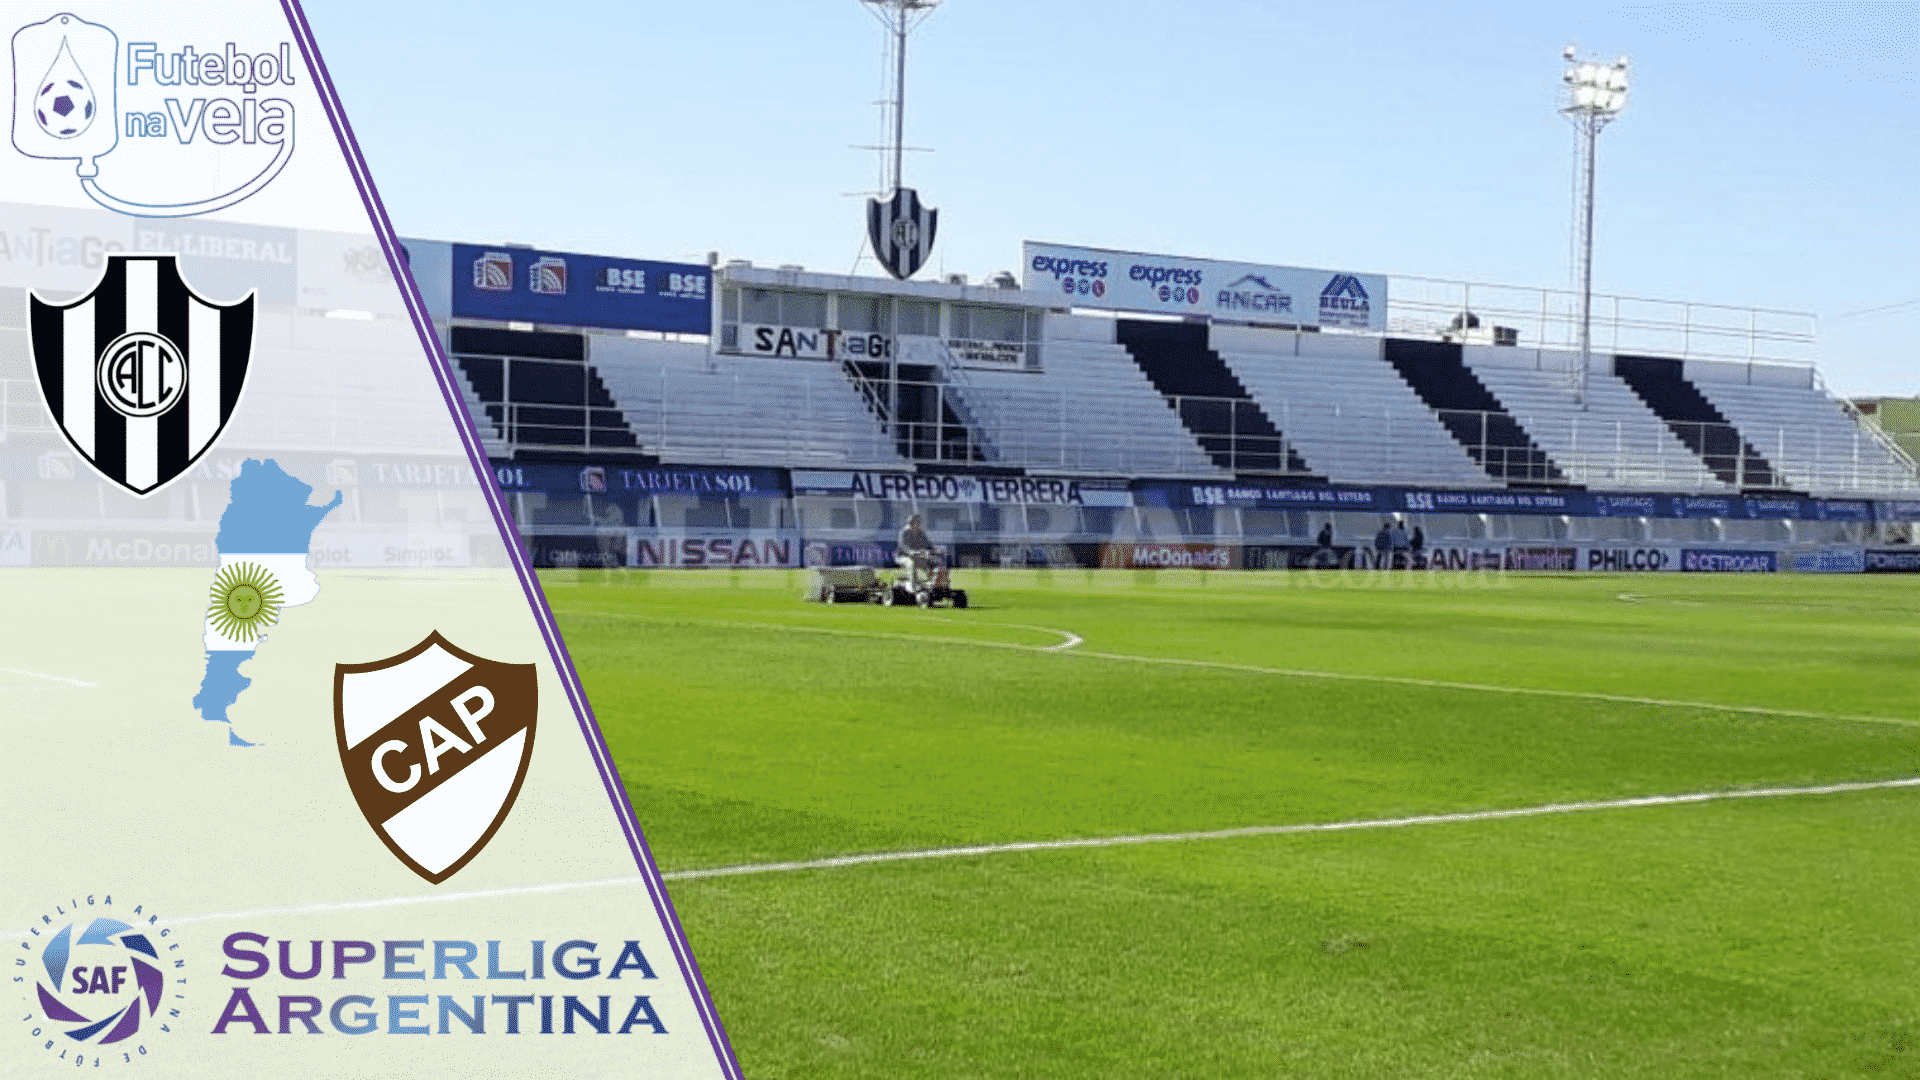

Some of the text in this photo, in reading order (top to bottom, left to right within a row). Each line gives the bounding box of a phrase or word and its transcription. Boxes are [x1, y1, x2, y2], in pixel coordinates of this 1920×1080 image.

[0, 227, 125, 269] ANTiaG
[182, 233, 292, 263] LIBERAL
[606, 268, 645, 288] BSE
[1032, 255, 1108, 280] express
[1129, 264, 1203, 289] express
[669, 273, 706, 293] BSE
[496, 467, 530, 487] OL
[621, 469, 757, 491] TARJETA SOL
[851, 472, 1084, 504] ALFREDO TERRERA
[85, 537, 219, 562] McDonal
[636, 537, 791, 567] NISSAN
[1132, 548, 1230, 566] McDonald's
[1588, 549, 1661, 570] PHILCO
